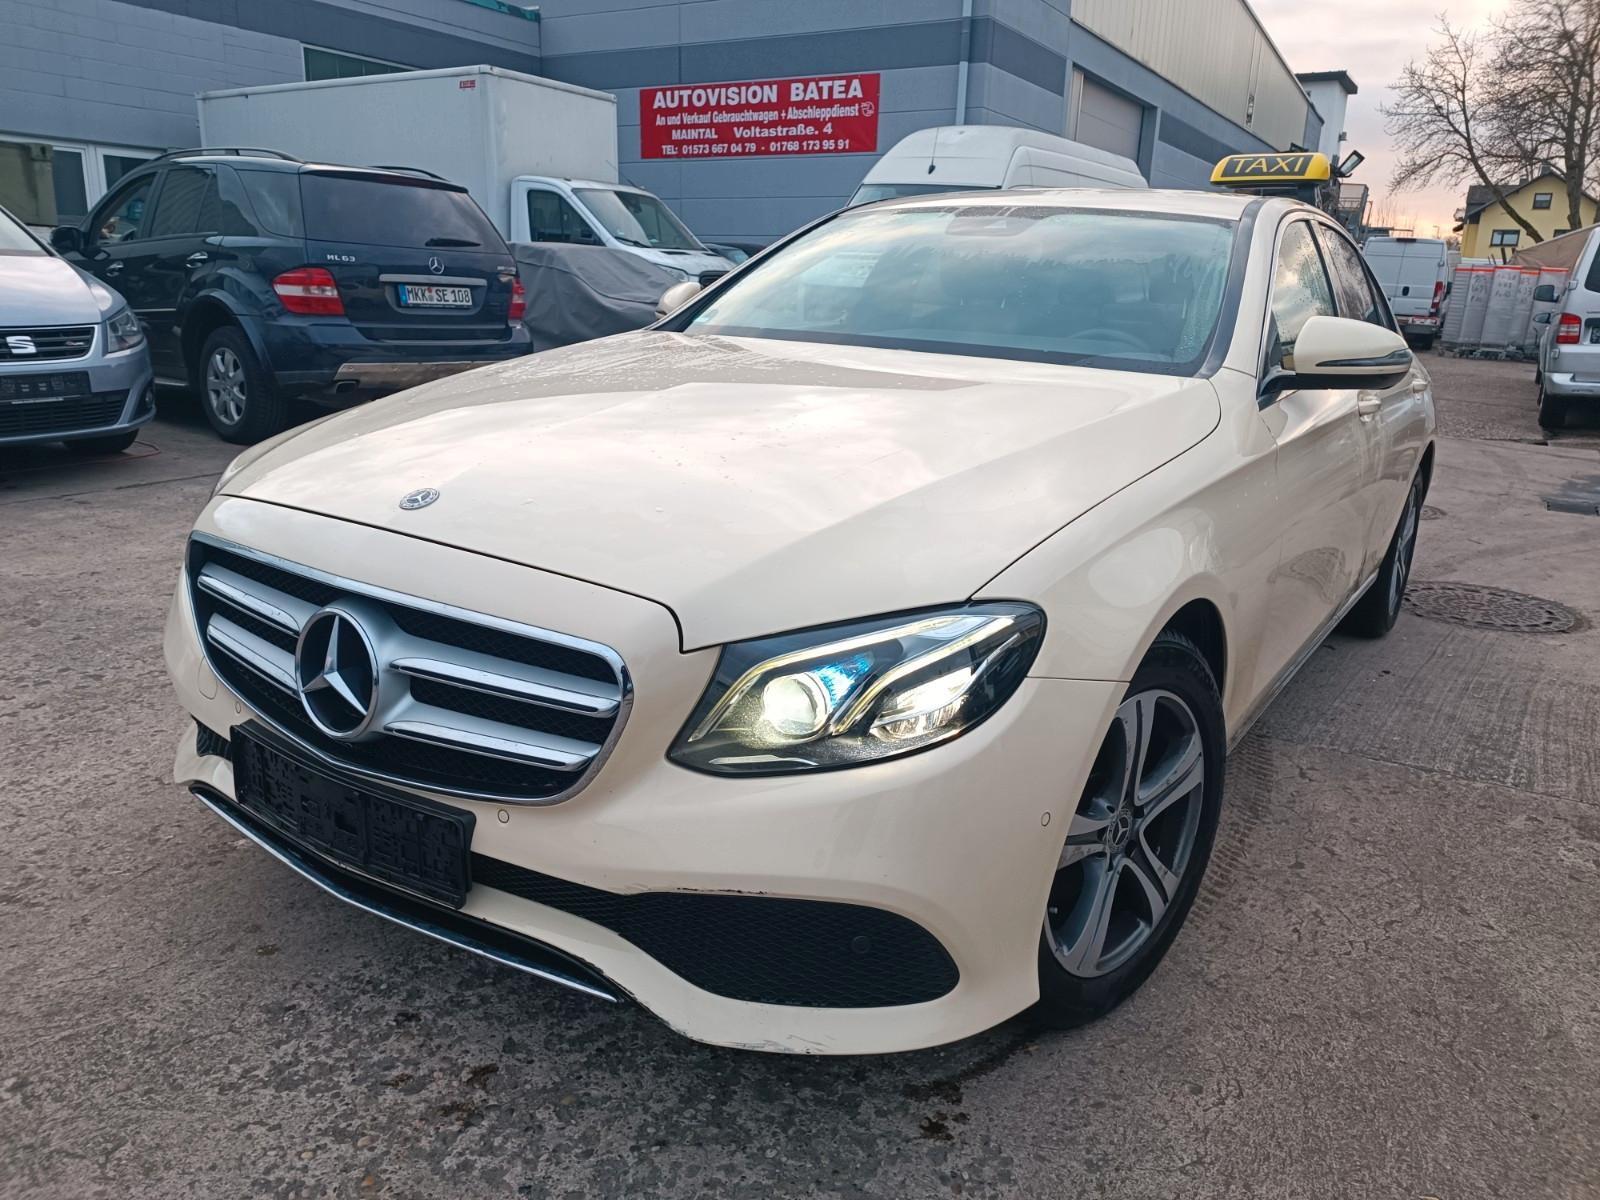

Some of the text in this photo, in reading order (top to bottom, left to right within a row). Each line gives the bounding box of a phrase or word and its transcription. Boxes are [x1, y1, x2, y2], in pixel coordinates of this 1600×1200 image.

[653, 78, 863, 109] AUTOVISION BATEA
[656, 113, 666, 126] An
[667, 112, 681, 125] und
[682, 111, 711, 125] Verkauf
[712, 108, 779, 124] Gebrauchtwagen
[671, 122, 833, 140] MAINTAL Voltastraße. 4
[662, 144, 678, 155] TEL:
[682, 143, 710, 154] 01573
[711, 143, 728, 154] 667
[730, 143, 742, 153] 04
[744, 142, 757, 153] 79
[770, 140, 799, 152] 01768
[802, 140, 820, 151] 173
[822, 139, 835, 150] 95
[837, 138, 850, 150] 91
[1233, 156, 1305, 174] TAXI
[406, 287, 471, 303] MKK SE 108
